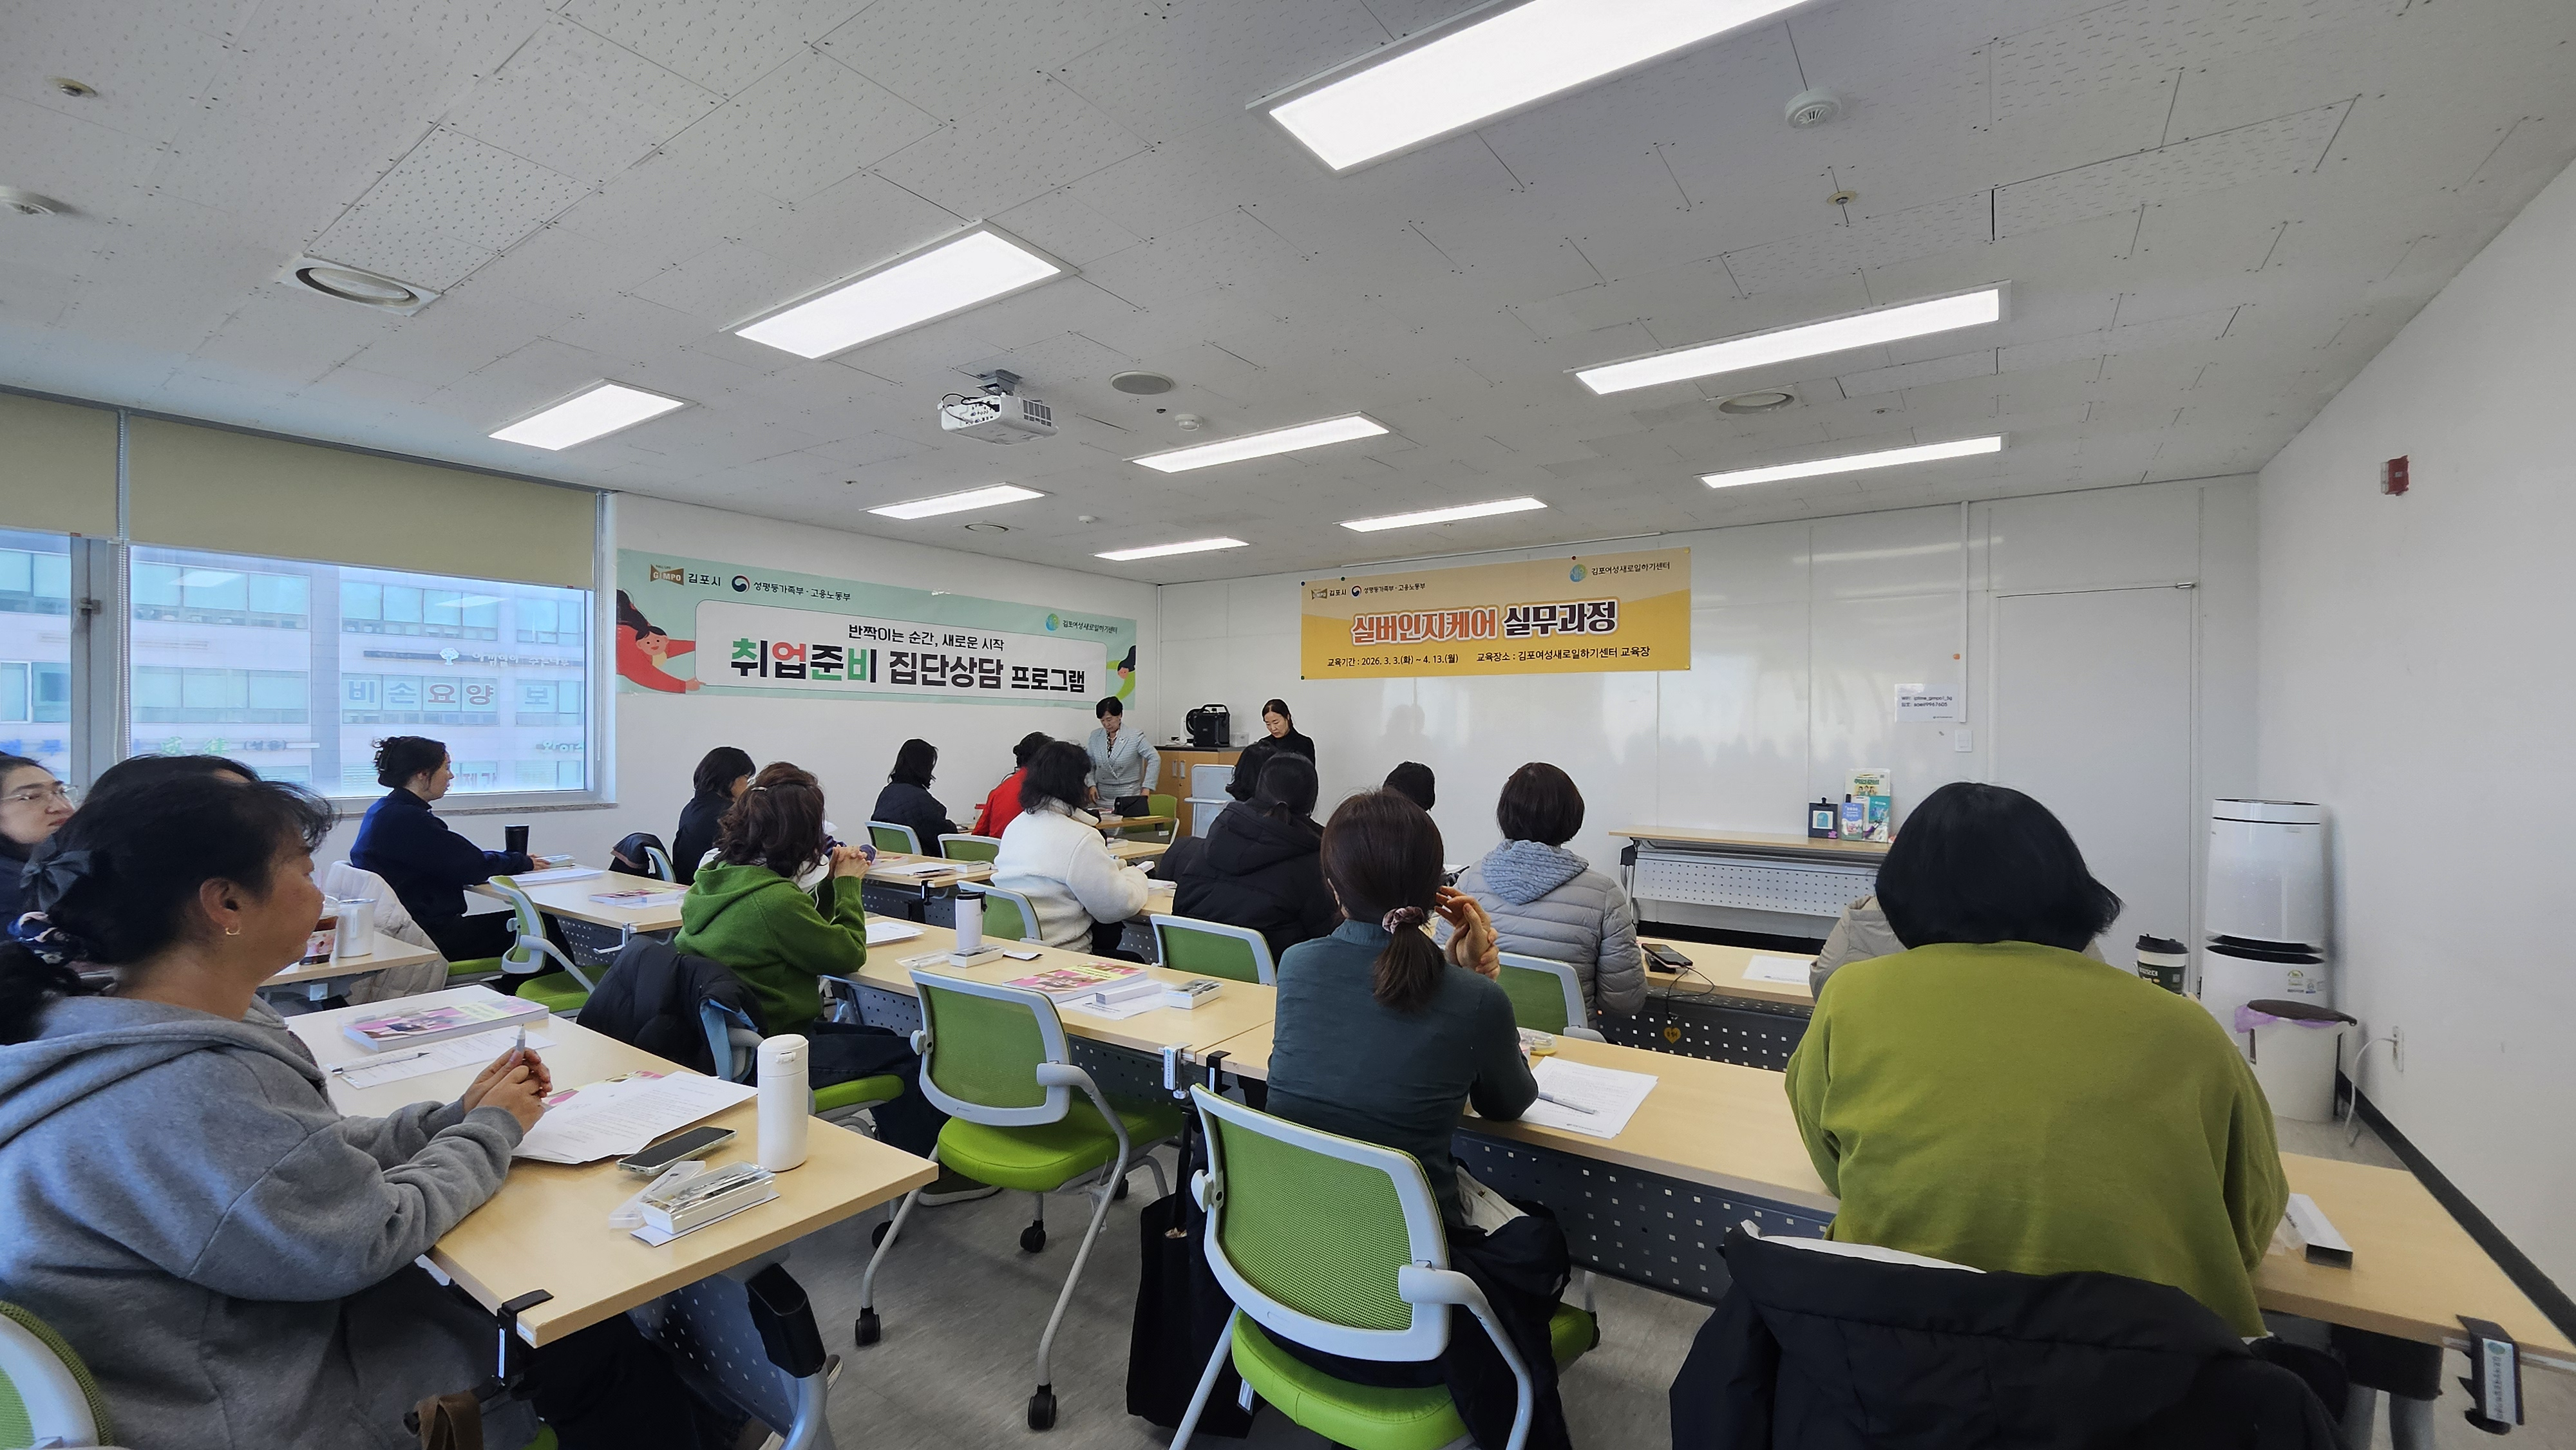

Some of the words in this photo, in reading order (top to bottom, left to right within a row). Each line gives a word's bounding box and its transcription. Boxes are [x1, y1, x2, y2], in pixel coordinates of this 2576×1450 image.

[1591, 561, 1670, 576] 김포여성새로일하기센터
[688, 572, 721, 587] 김포시
[753, 581, 804, 595] 성평등가족부
[810, 588, 851, 601] 고용노동부
[1063, 619, 1118, 634] 김포여성새로일하기센터
[1353, 610, 1494, 643] 실버인지케어
[1504, 601, 1616, 636] 실무과정
[848, 624, 904, 644] 반짝이는
[909, 630, 938, 648] 순간,
[942, 634, 978, 650] 새로운
[982, 638, 1005, 652] 시작
[1518, 646, 1618, 661] 김포여성새로일하기센터
[1620, 646, 1651, 657] 교육장
[731, 637, 878, 684] 취업준비
[889, 650, 1004, 690] 집단상담
[1011, 666, 1085, 693] 프로그램
